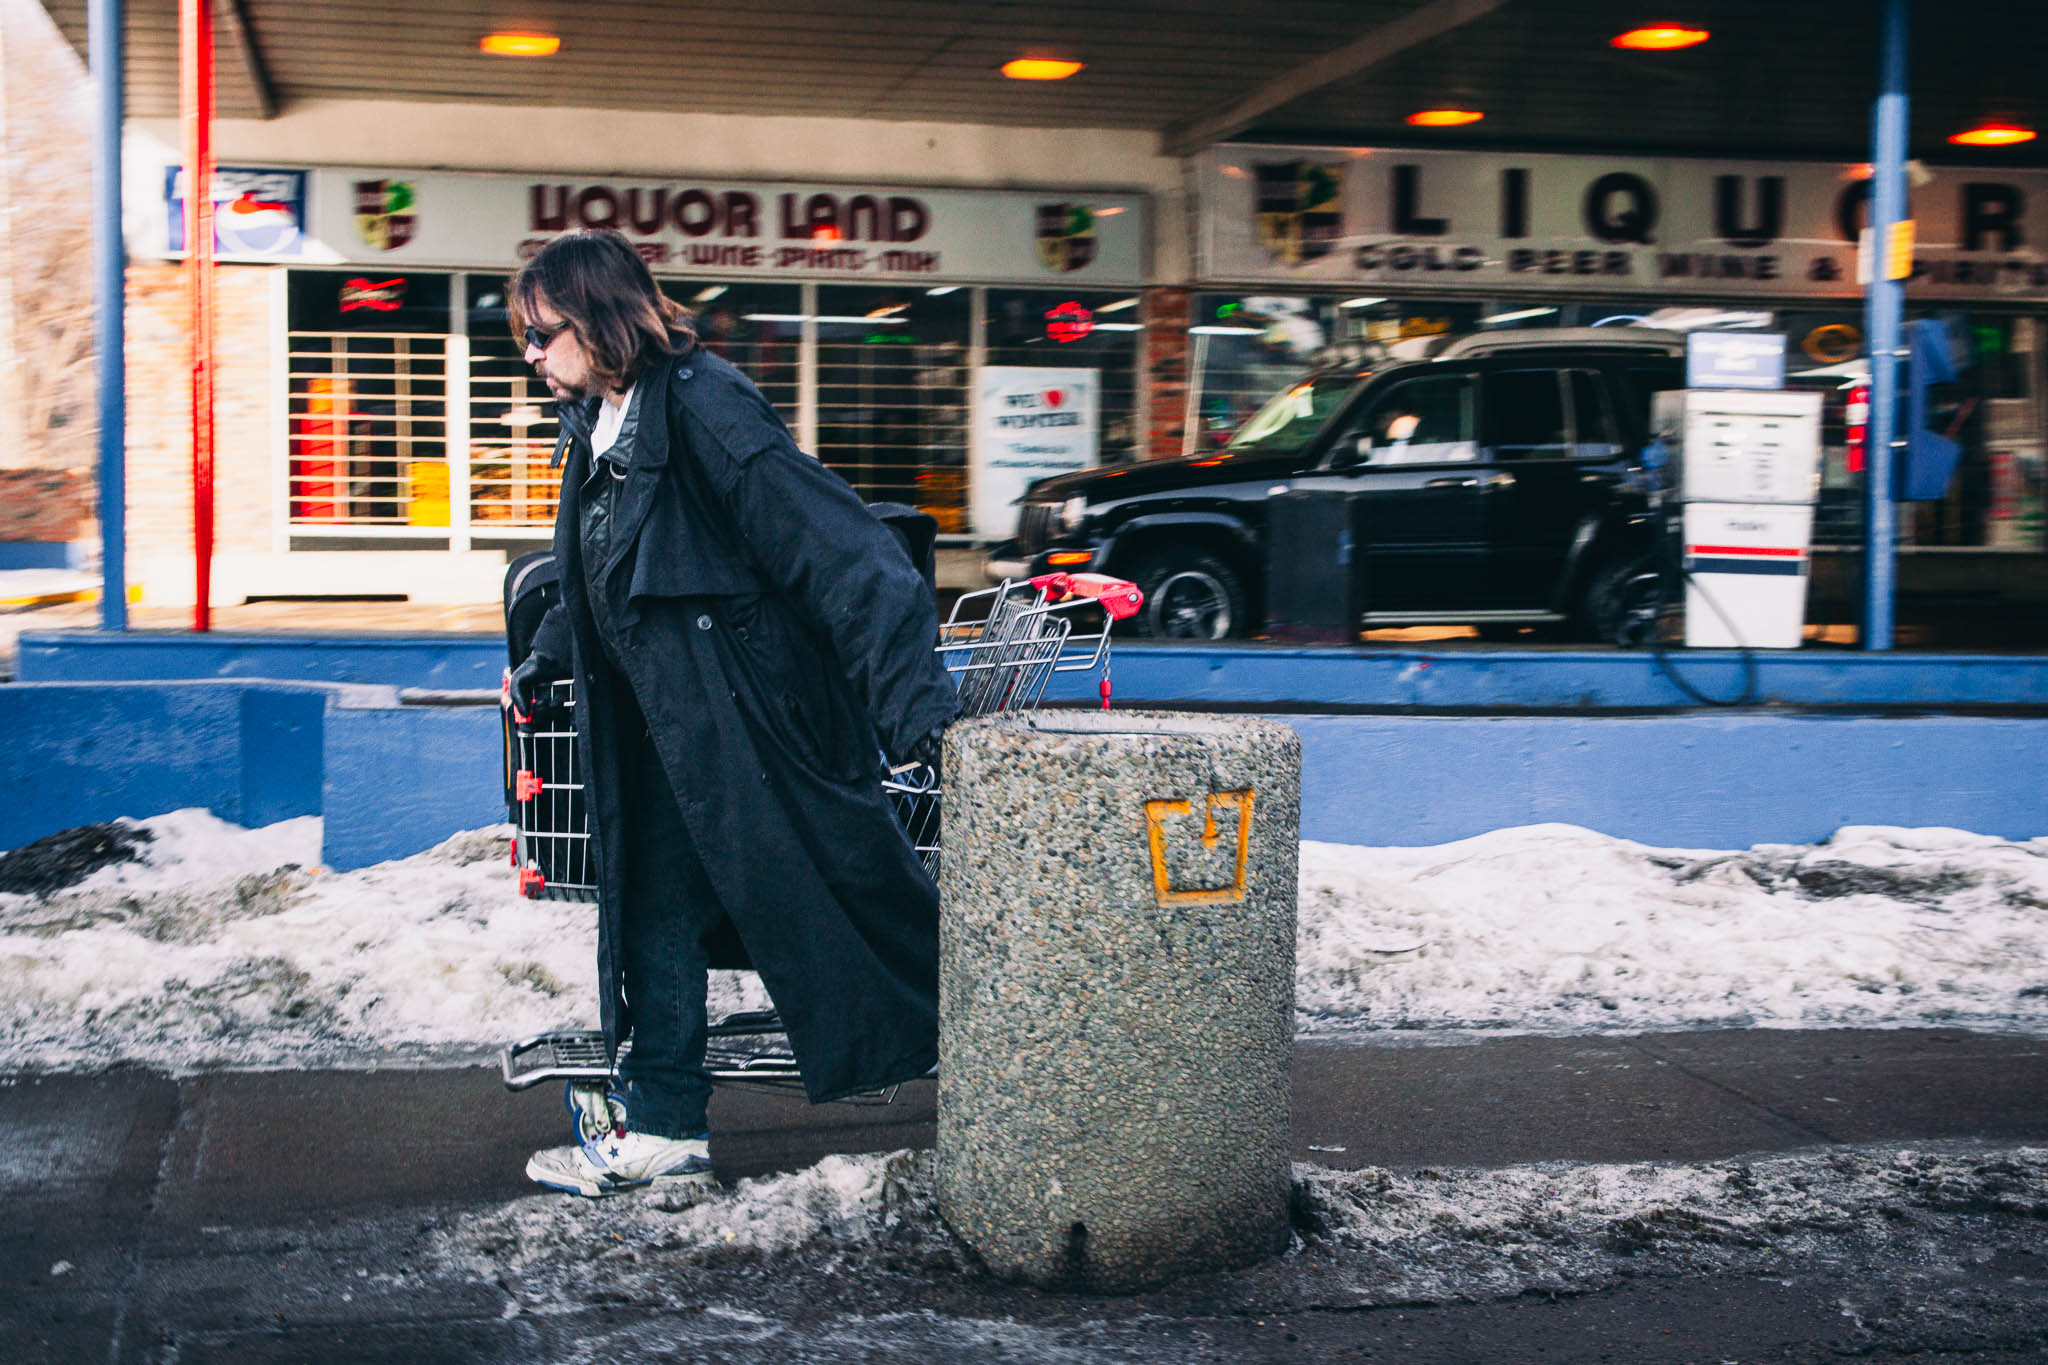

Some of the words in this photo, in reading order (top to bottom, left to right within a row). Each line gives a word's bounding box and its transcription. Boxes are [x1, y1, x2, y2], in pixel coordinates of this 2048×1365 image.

[530, 185, 761, 236] LIQUOR
[780, 193, 929, 242] LAND
[1508, 248, 1634, 275] BEER
